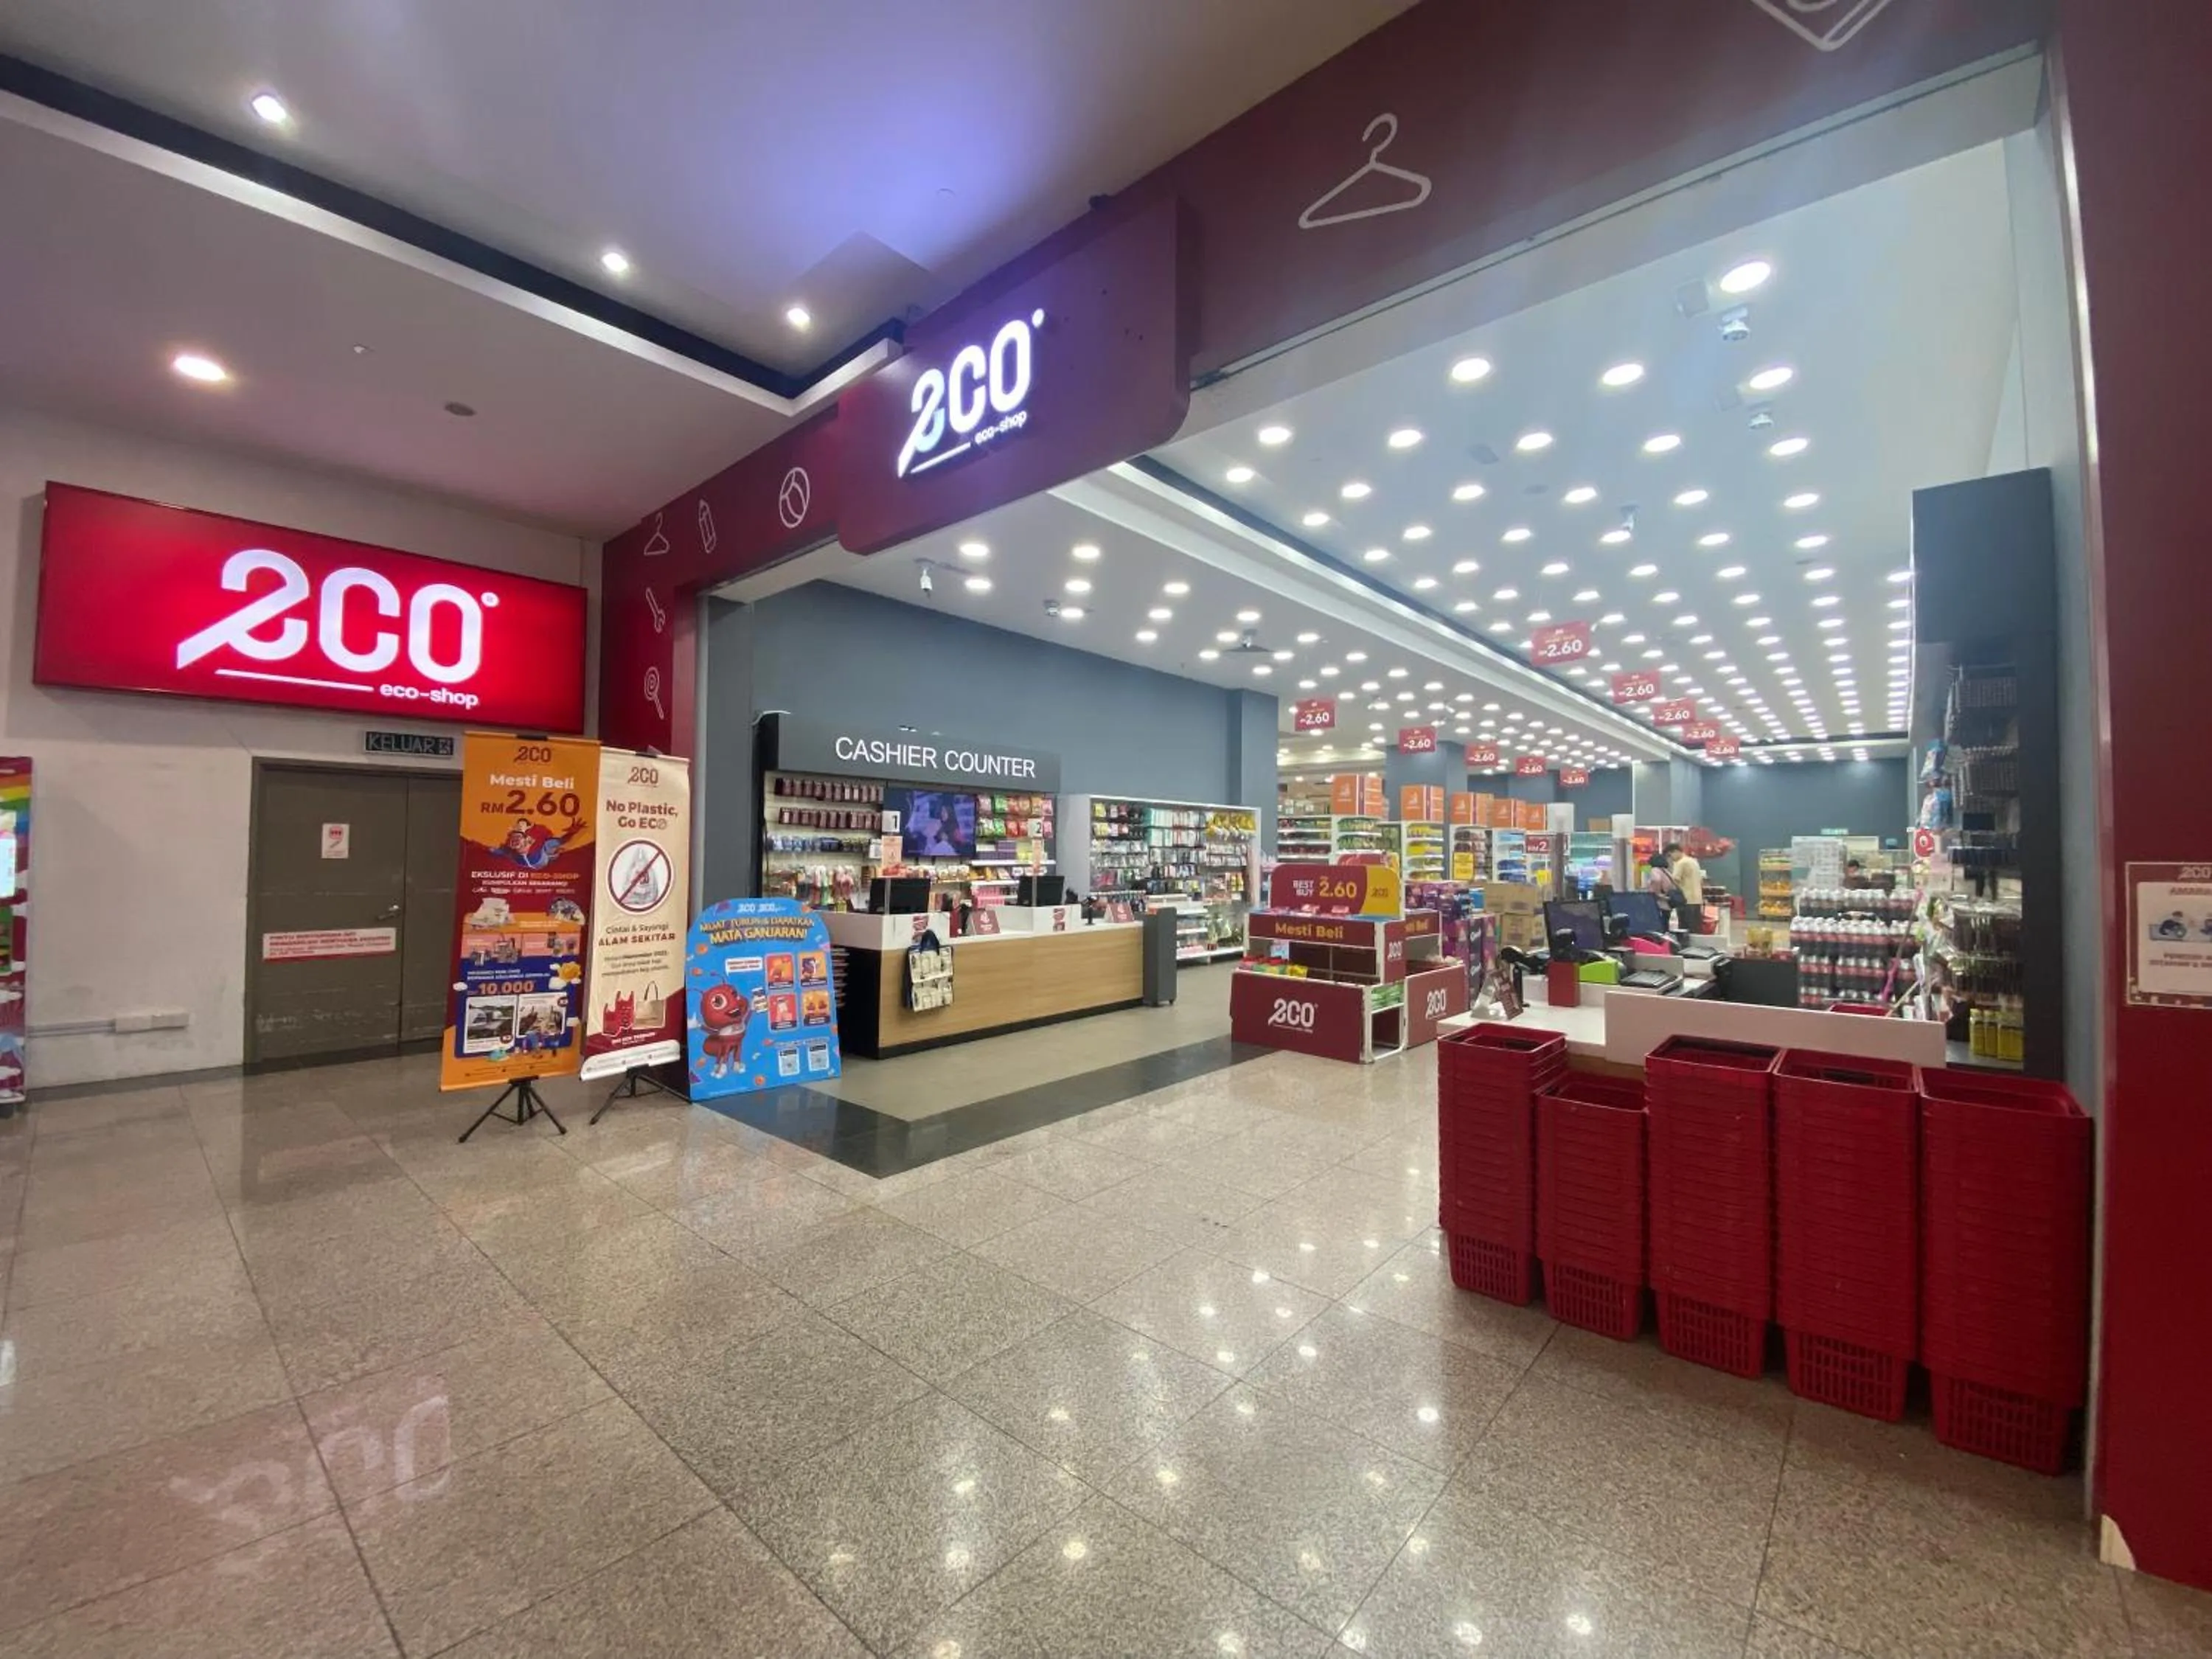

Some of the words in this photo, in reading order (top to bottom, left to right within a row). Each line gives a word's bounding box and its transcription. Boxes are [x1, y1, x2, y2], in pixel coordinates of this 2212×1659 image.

[974, 410, 1028, 445] eco-shop
[379, 683, 479, 709] eco-shop
[369, 734, 436, 754] KELUAR
[835, 737, 937, 769] CASHIER
[945, 750, 1036, 779] COUNTER
[490, 773, 538, 787] Mesti
[542, 776, 574, 789] Beli
[606, 799, 626, 812] No
[627, 801, 678, 818] Plastic,
[618, 815, 636, 828] Go
[639, 817, 667, 830] ECO
[891, 815, 898, 830] 1
[1036, 822, 1042, 834] 2
[1293, 880, 1315, 888] BEST
[1295, 888, 1315, 897] BUY
[1318, 880, 1357, 898] 2.60
[710, 930, 742, 945] MATA
[745, 926, 808, 939] GANJARAN!
[1275, 922, 1312, 936] Mesti
[1316, 925, 1343, 939] Beli
[599, 936, 628, 947] ALAM
[631, 933, 675, 943] SEKITAR
